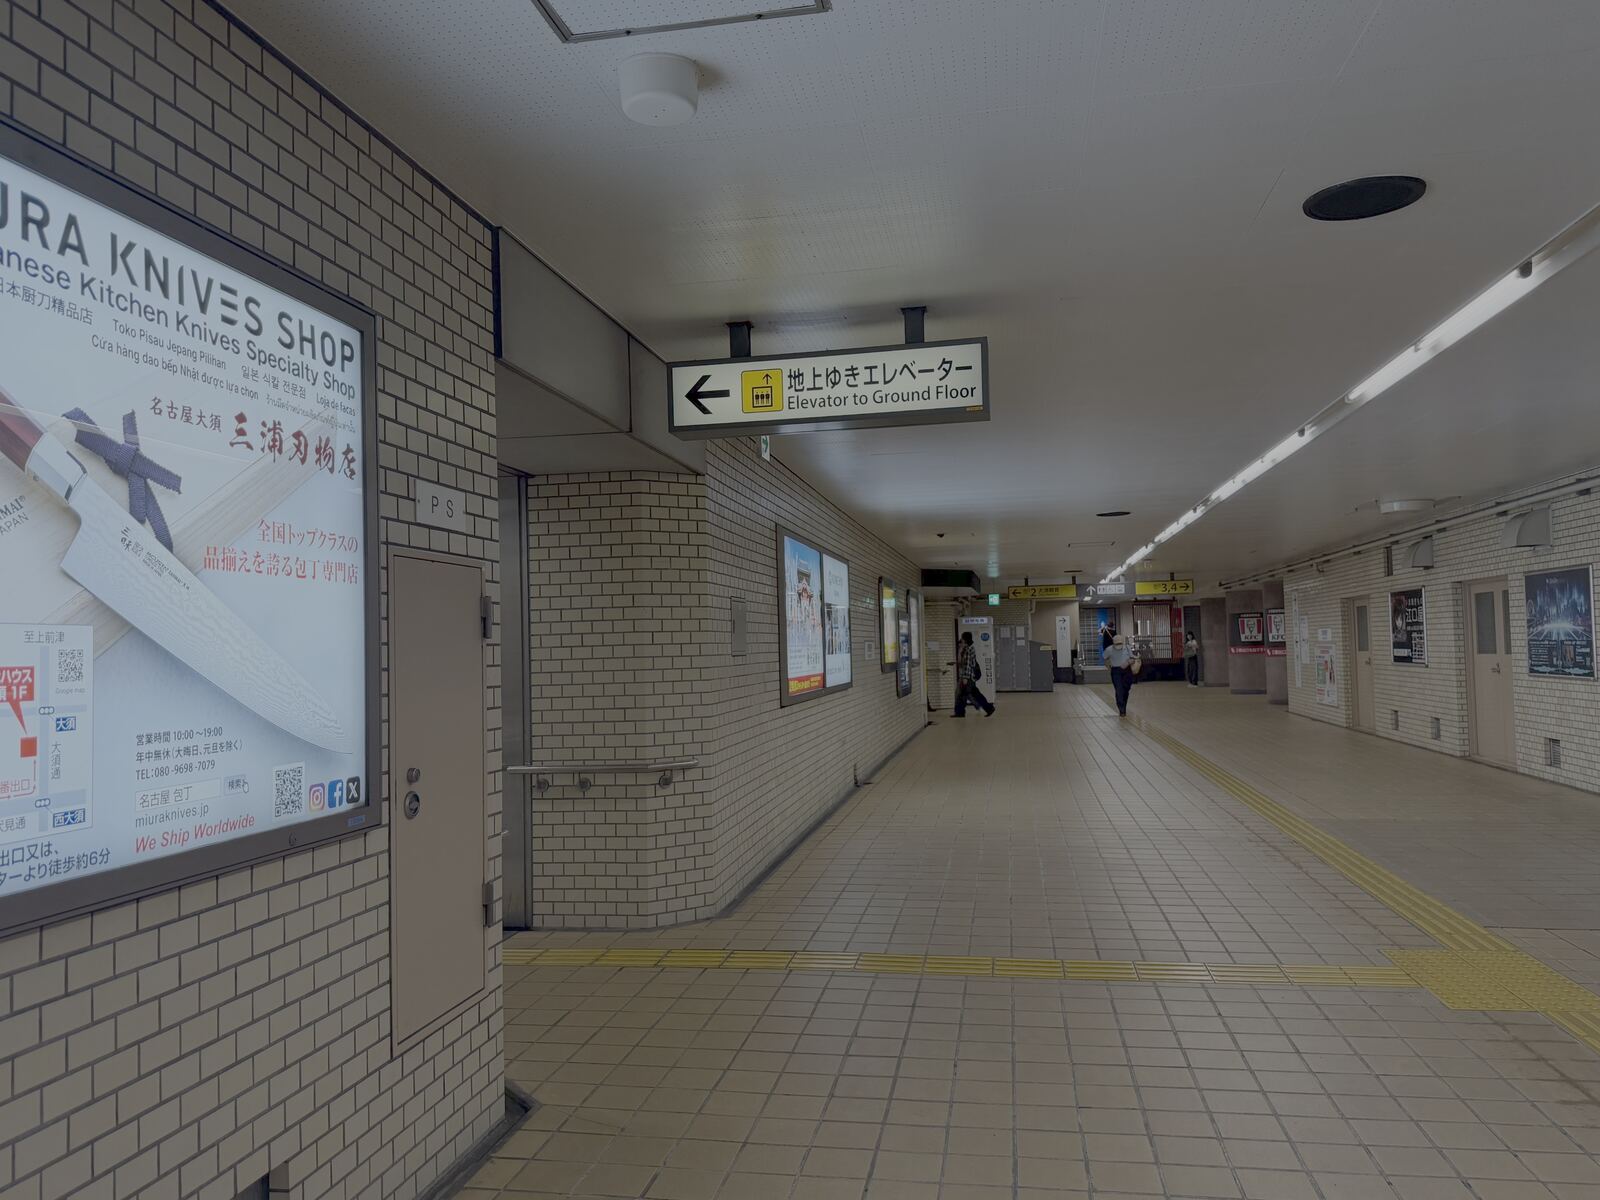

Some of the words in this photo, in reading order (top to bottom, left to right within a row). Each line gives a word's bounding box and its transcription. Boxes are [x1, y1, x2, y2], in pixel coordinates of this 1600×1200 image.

[110, 231, 263, 337] KNIVES
[277, 311, 355, 372] SHOP
[0, 246, 70, 290] nese
[80, 272, 168, 328] Kitchen
[176, 311, 241, 354] Knives
[246, 340, 319, 386] Specialty
[323, 371, 355, 400] Shop
[113, 319, 137, 338] Toko
[139, 328, 164, 348] Pisau
[166, 339, 197, 362] Jepang
[199, 350, 227, 370] Pilihan
[142, 352, 159, 367] dao
[787, 357, 973, 393] 地上ゆきエレベーター
[788, 393, 848, 410] Elevator
[852, 391, 868, 406] to
[872, 387, 931, 405] Ground
[936, 384, 976, 400] Floor
[150, 396, 222, 433] 名古屋大須
[229, 411, 356, 480] 三浦刃物店
[258, 519, 359, 553] 全国トップクラスの
[203, 545, 359, 585] 品揃えを誇る包丁専門店
[136, 731, 171, 746] 営業時間
[140, 790, 170, 808] 名古屋
[173, 785, 193, 802] 包丁
[135, 802, 209, 828] miuraknives.jp
[136, 835, 157, 853] We
[160, 828, 190, 847] Ship
[193, 813, 256, 839] Worldwide
